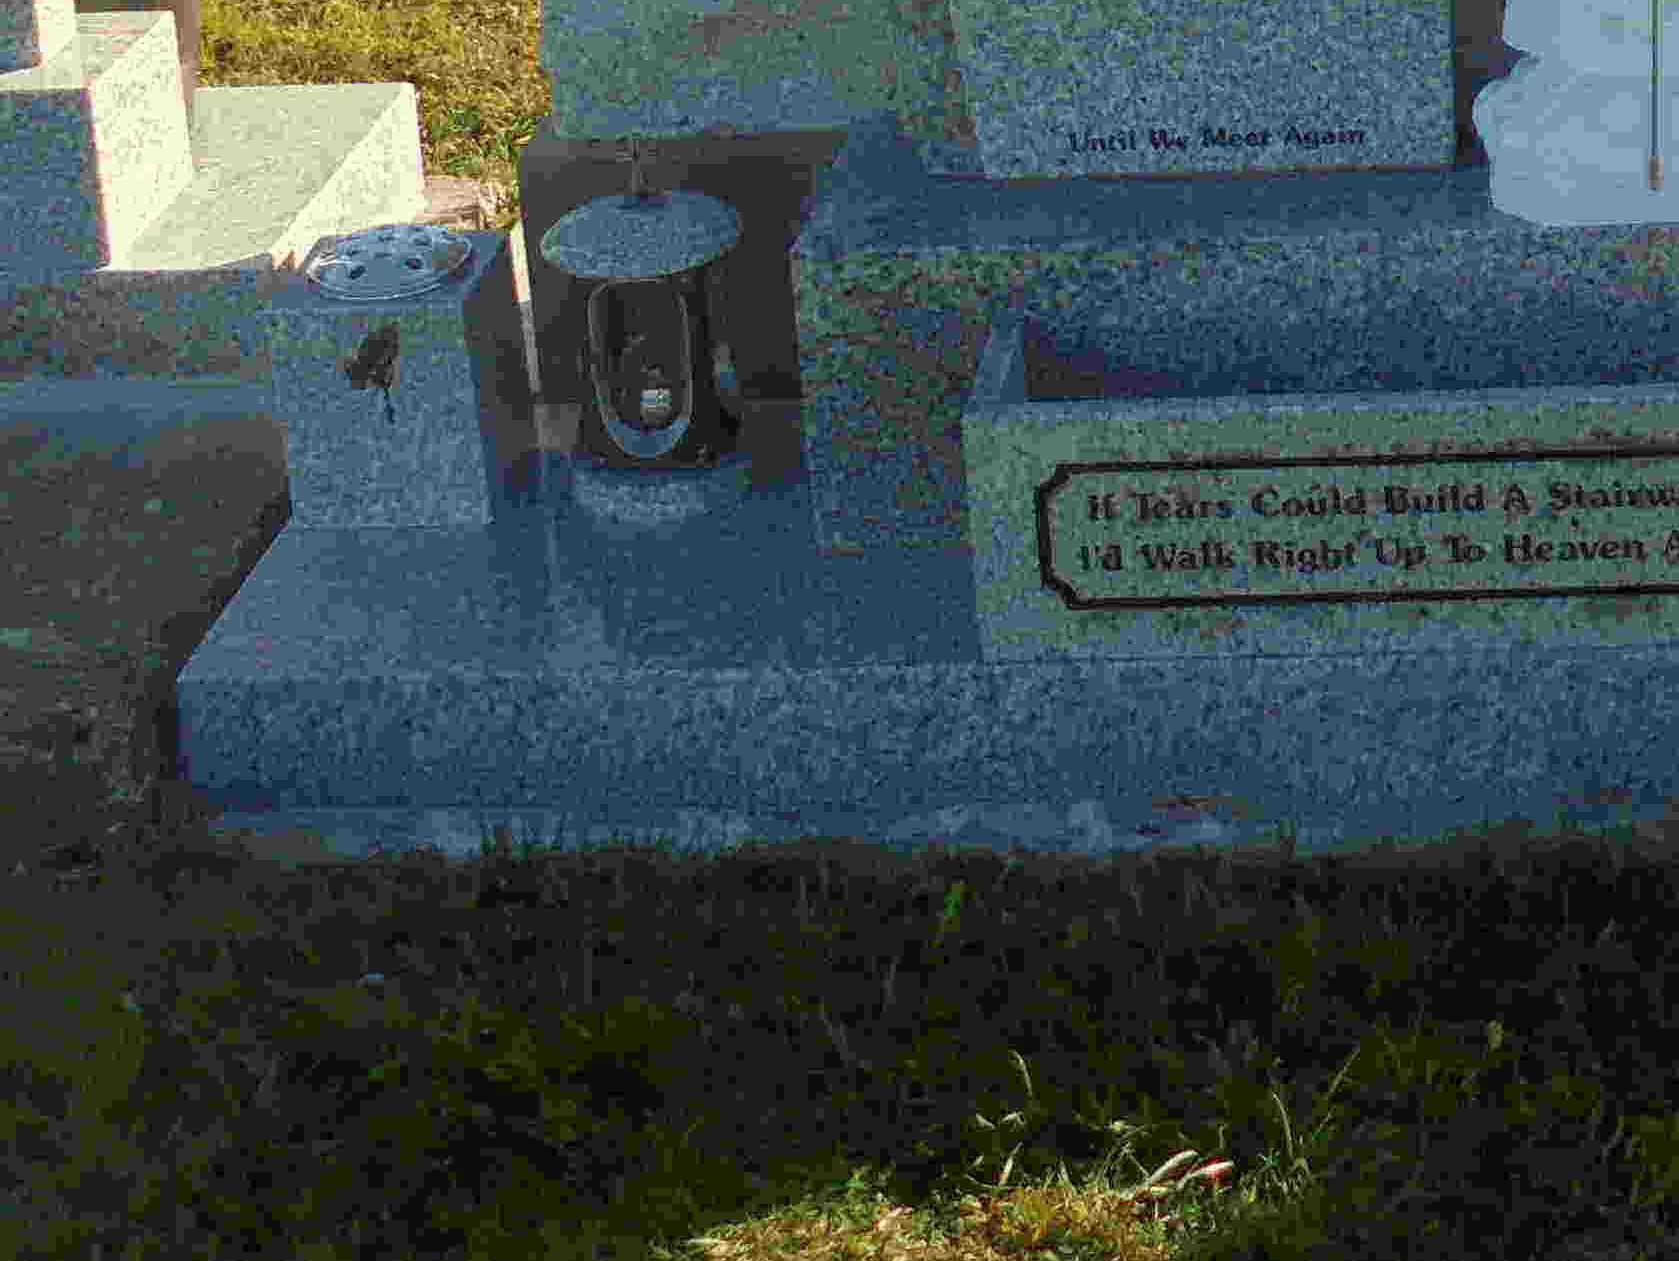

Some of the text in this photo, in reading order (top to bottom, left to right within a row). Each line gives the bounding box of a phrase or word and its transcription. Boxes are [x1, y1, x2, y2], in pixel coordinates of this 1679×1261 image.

[1068, 125, 1365, 153] Until We Meet Again
[1087, 490, 1121, 520] If
[1134, 490, 1236, 522] Tears
[1250, 484, 1367, 518] Could
[1383, 484, 1486, 516] Build
[1503, 483, 1531, 514] A
[1080, 541, 1122, 572] I'd
[1138, 540, 1236, 573] Walk
[1251, 537, 1360, 574] Right
[1375, 538, 1427, 570] Up
[1443, 533, 1491, 564] To
[1503, 531, 1646, 564] Heaven
